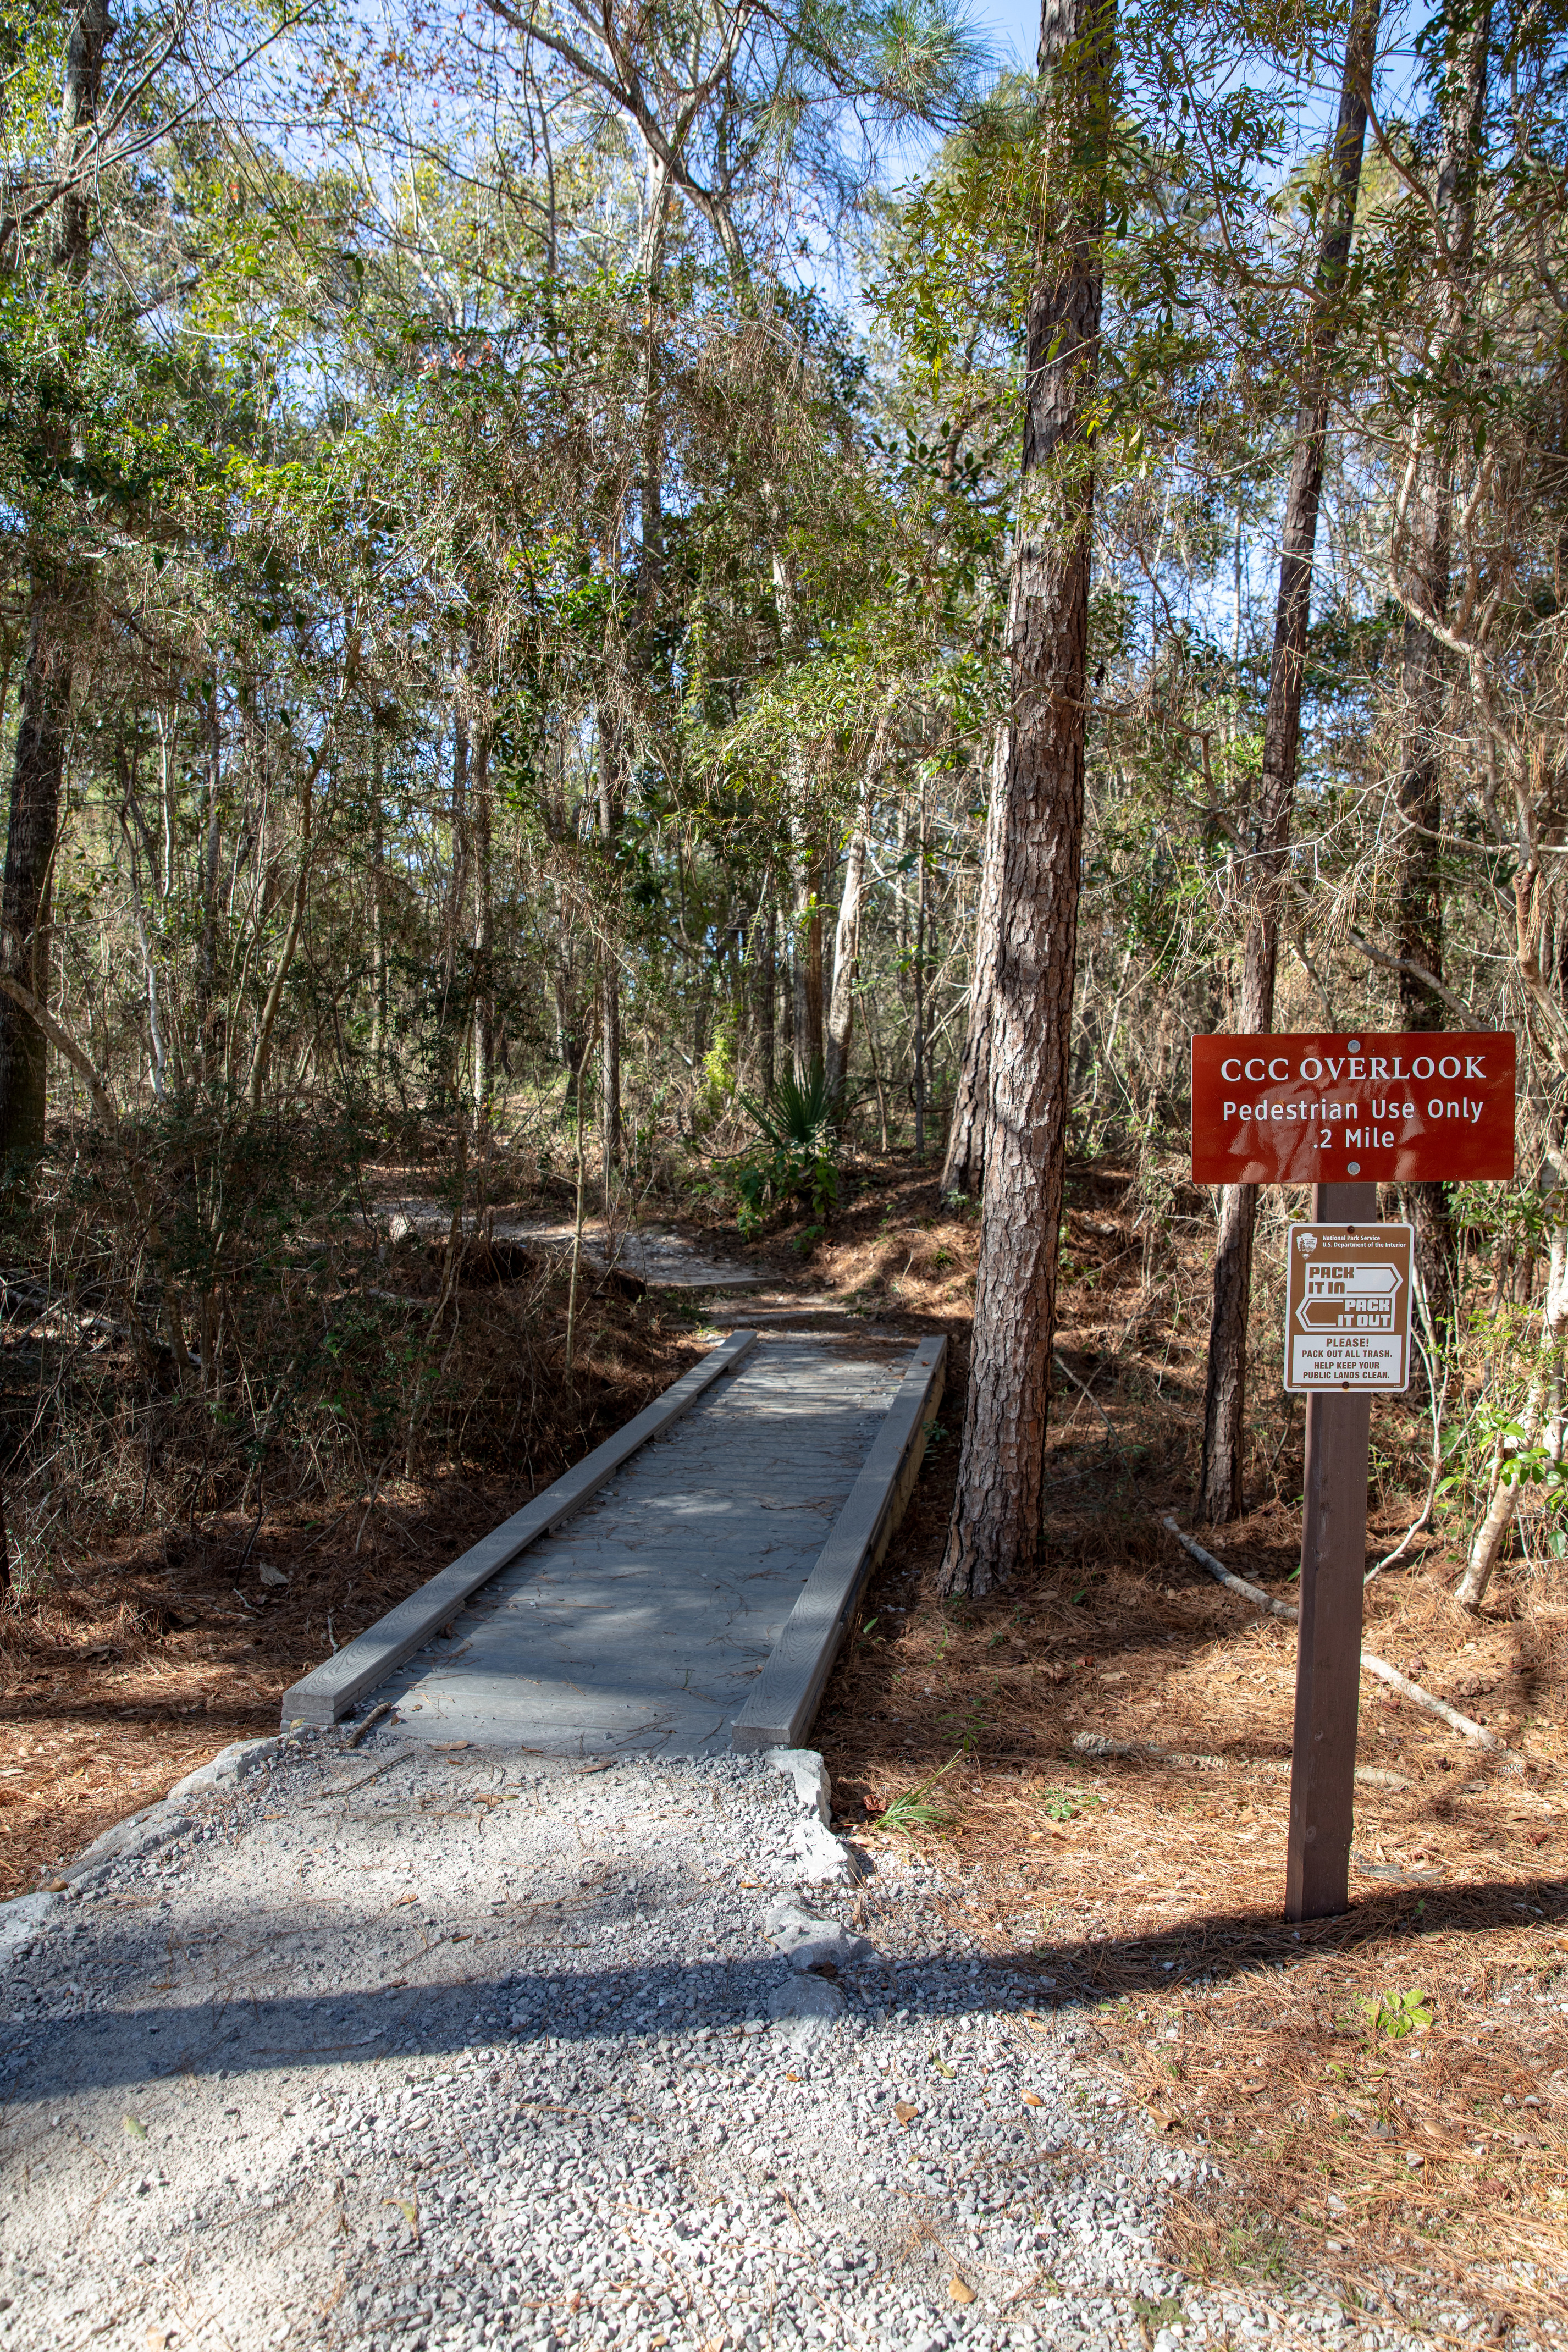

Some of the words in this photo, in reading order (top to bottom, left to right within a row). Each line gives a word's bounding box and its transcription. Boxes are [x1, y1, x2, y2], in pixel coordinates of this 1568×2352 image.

[1221, 1058, 1289, 1081] CCC
[1300, 1056, 1487, 1080] OVERLOOK
[1223, 1098, 1358, 1121] Pedestrian
[1372, 1100, 1415, 1119] Use
[1428, 1098, 1484, 1123] Only
[1313, 1129, 1332, 1149] .2
[1346, 1127, 1395, 1148] Mile
[1309, 1267, 1354, 1278] PACK
[1308, 1282, 1324, 1294] IT
[1328, 1282, 1345, 1294] IN
[1345, 1299, 1390, 1311] PACK
[1338, 1315, 1354, 1327] IT
[1357, 1315, 1390, 1327] OUT
[1326, 1338, 1369, 1347] PLEASE!
